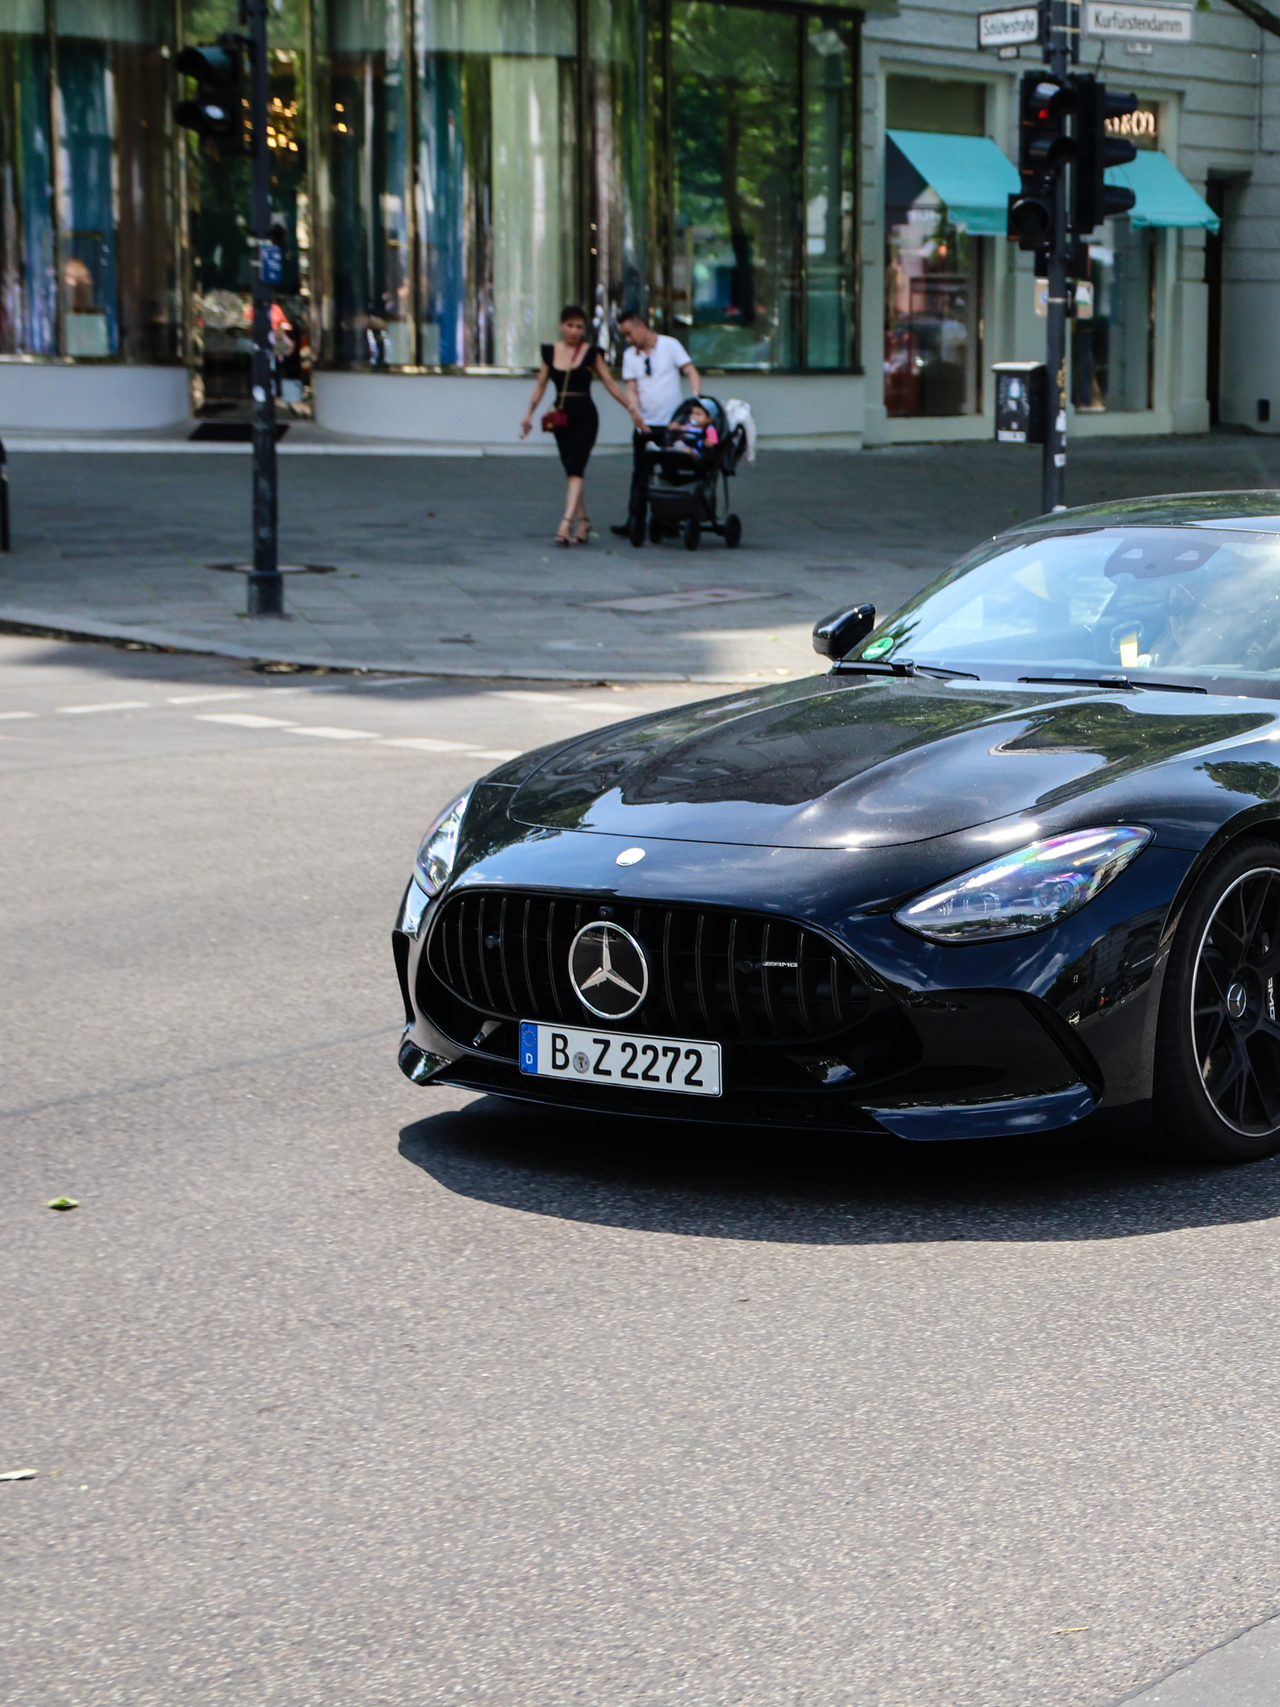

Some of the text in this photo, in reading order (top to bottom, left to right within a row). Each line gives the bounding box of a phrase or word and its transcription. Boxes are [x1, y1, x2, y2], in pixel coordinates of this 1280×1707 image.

[982, 13, 1036, 37] Schlüterstraße
[1094, 9, 1183, 33] Kurfürstendamm
[526, 1053, 534, 1064] D
[551, 1032, 704, 1087] B Z 2272
